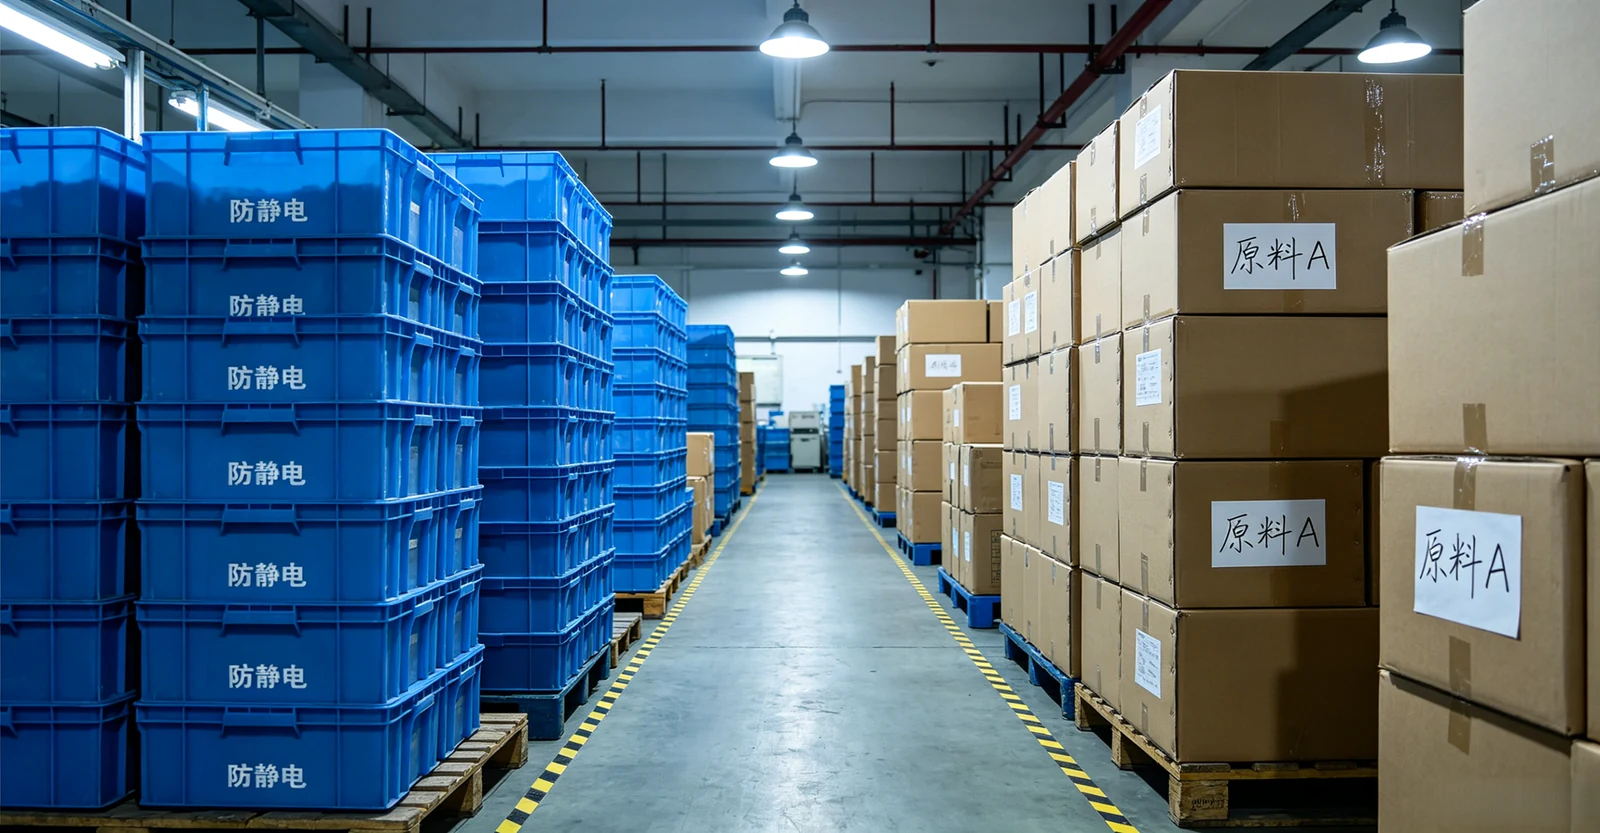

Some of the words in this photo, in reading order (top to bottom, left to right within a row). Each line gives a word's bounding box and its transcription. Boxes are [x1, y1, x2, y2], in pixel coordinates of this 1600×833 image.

[229, 197, 308, 223] 防静电
[1231, 236, 1330, 280] 原料A
[229, 293, 306, 317] 防静电
[227, 364, 307, 390] 防静电
[227, 460, 306, 486] 防静电
[1219, 513, 1320, 556] 原料A
[227, 562, 307, 588] 防静电
[1419, 529, 1510, 600] 原料A
[227, 663, 308, 689] 防静电
[227, 763, 307, 789] 防静电
